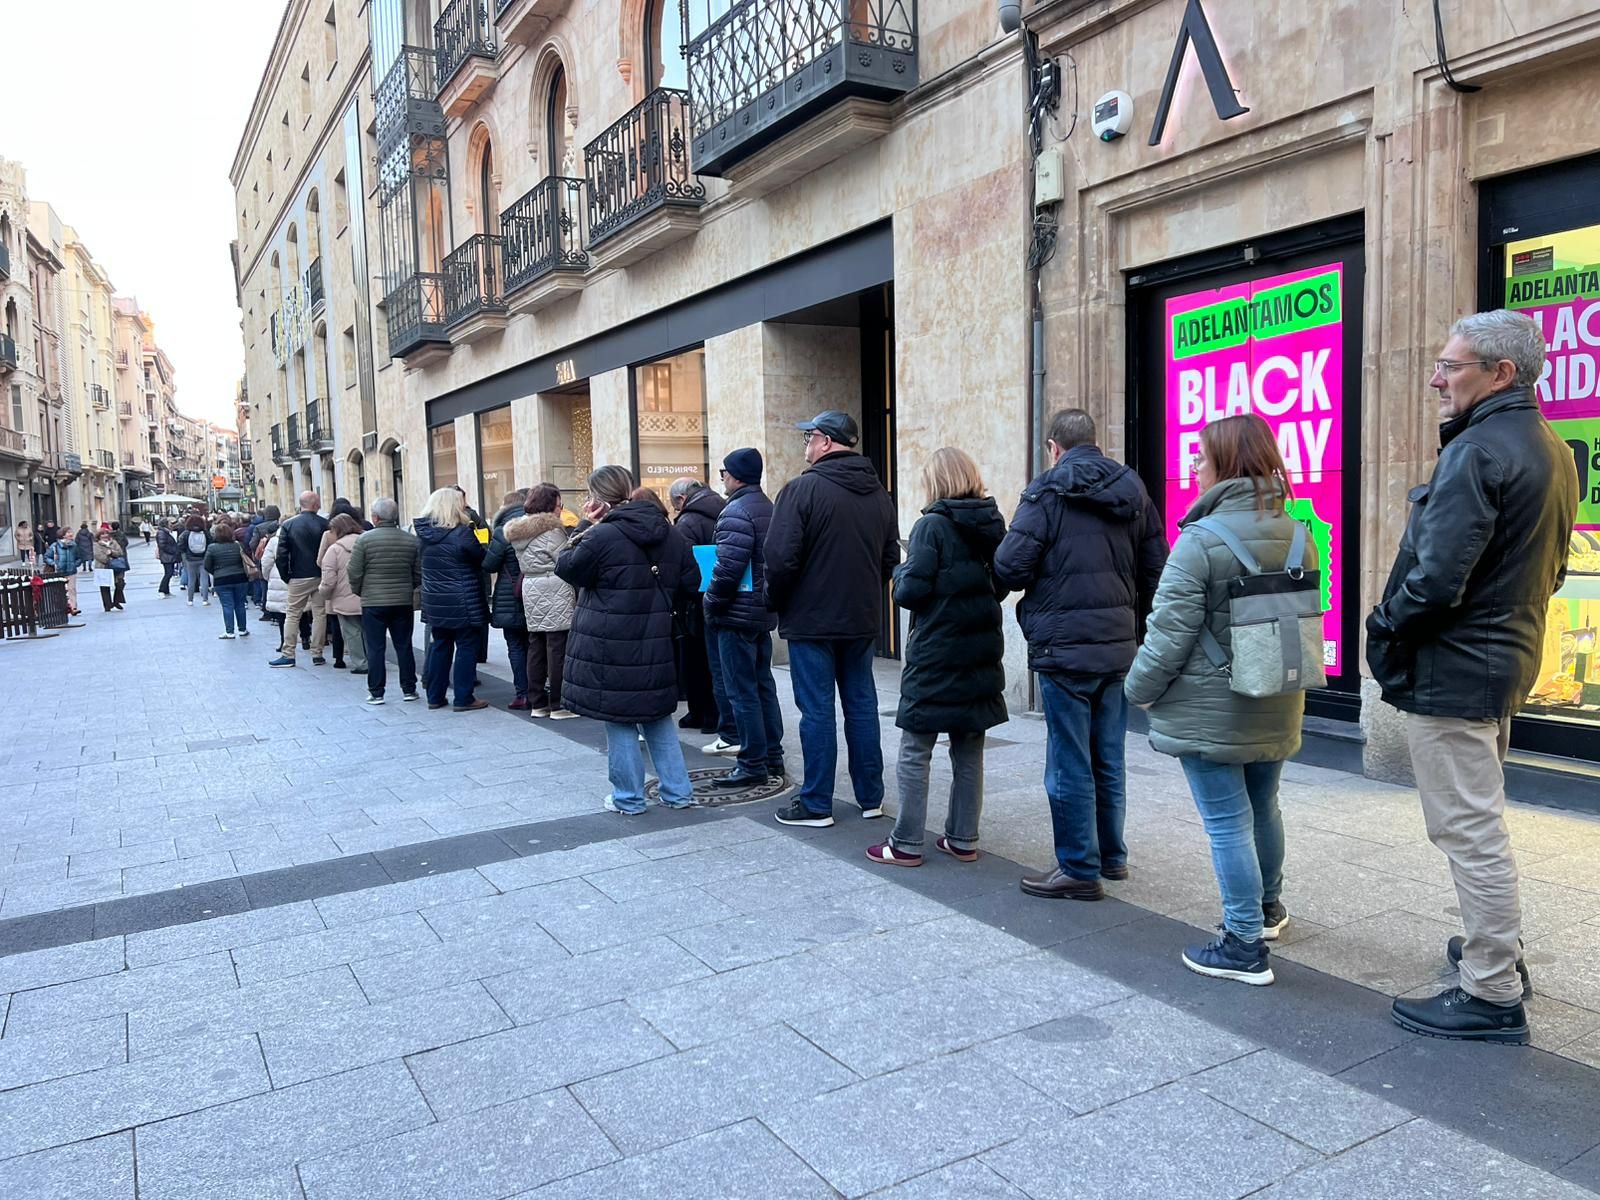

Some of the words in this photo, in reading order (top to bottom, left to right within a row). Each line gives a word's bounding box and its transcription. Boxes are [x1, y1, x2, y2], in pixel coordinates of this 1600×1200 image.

[1177, 283, 1333, 349] ADELANTAMOS
[1510, 271, 1600, 303] ADELANTA
[1179, 348, 1332, 426] BLACK
[1533, 353, 1600, 402] RID
[1179, 417, 1333, 490] FAY
